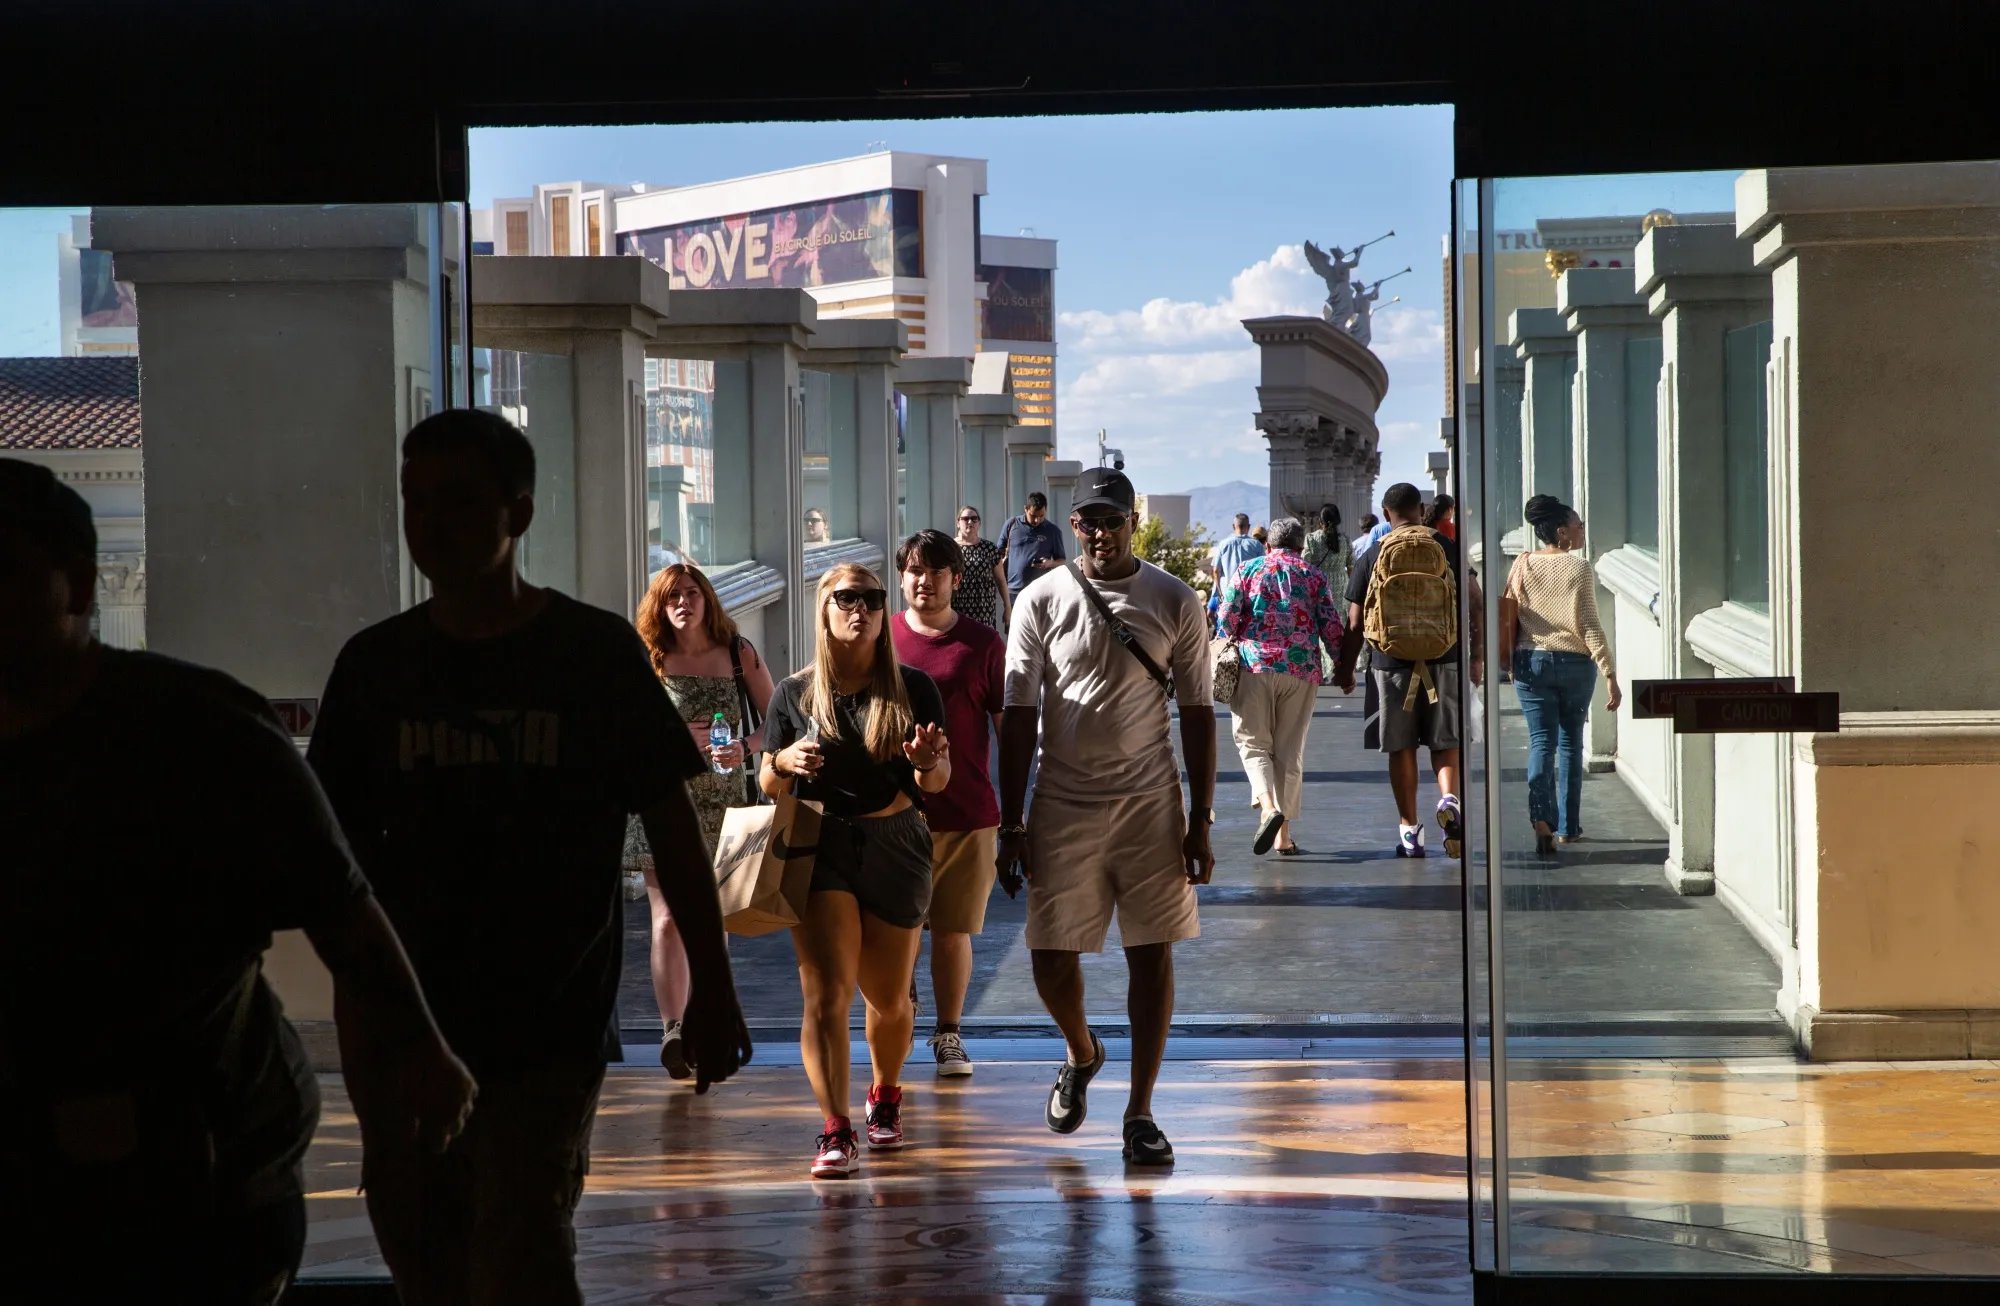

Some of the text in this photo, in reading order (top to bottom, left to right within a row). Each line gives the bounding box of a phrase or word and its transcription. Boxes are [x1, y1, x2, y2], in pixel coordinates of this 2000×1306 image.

[787, 236, 822, 252] CIRQUE
[823, 233, 838, 245] DU
[839, 228, 873, 243] SOLEIL
[664, 222, 769, 290] LOVE
[1721, 700, 1792, 722] CAUTION
